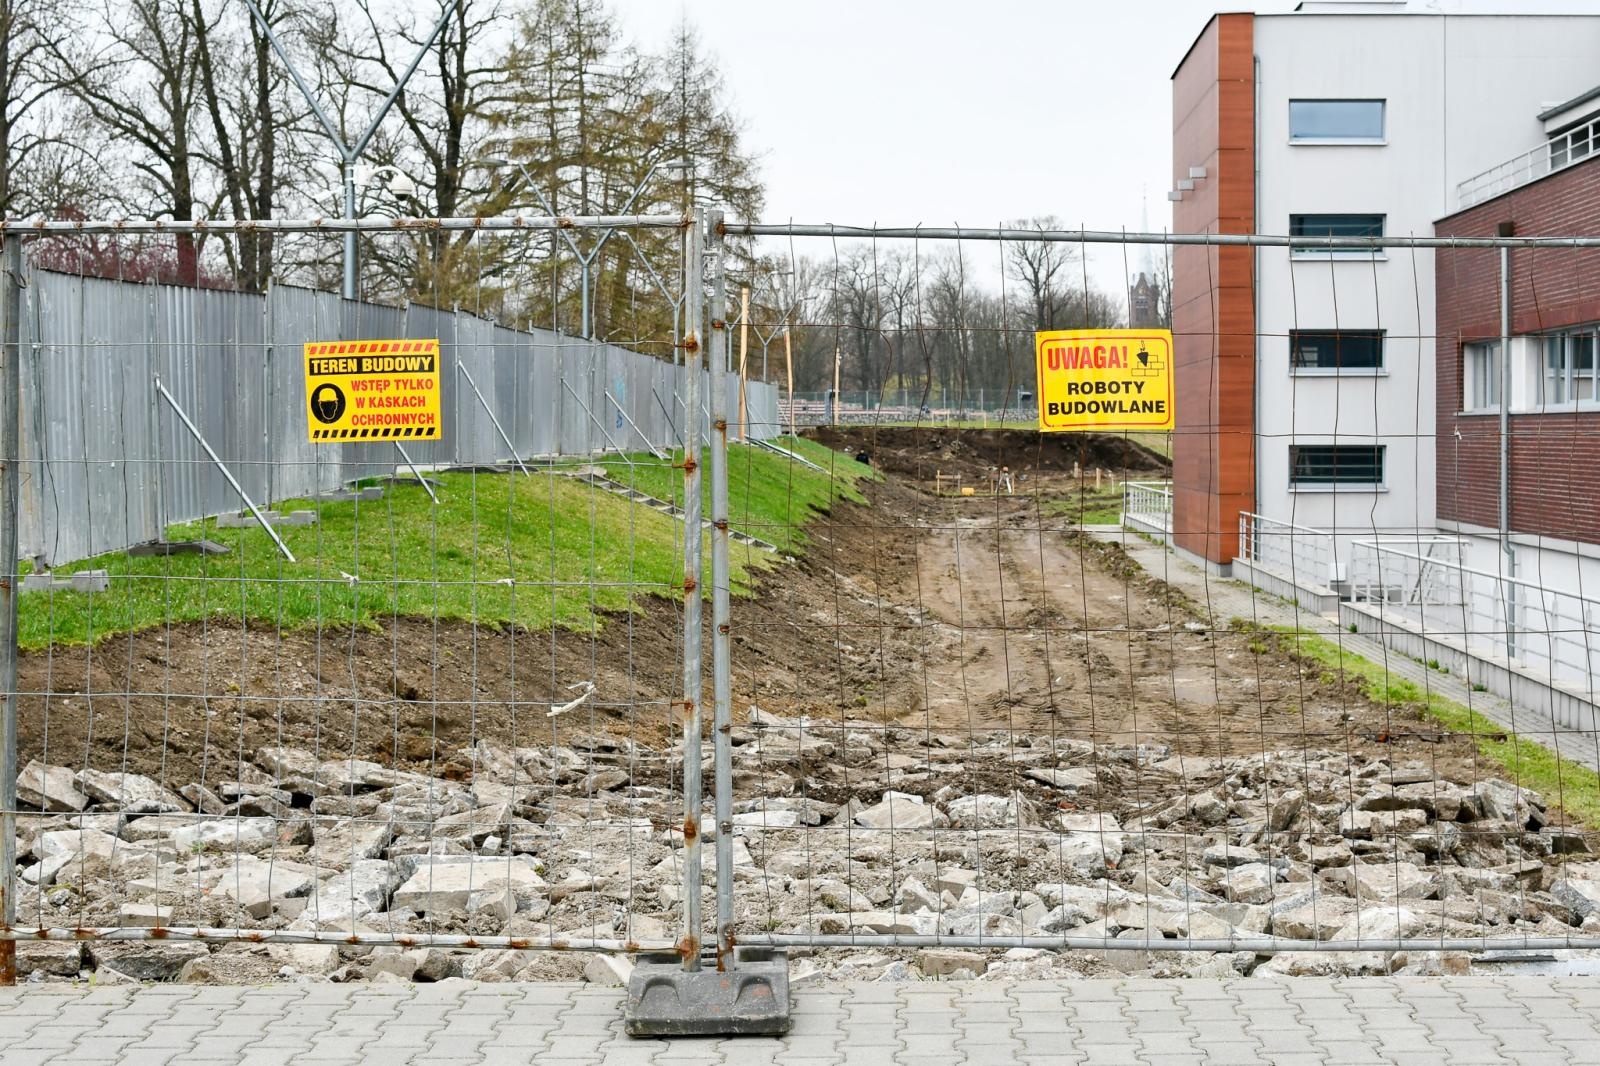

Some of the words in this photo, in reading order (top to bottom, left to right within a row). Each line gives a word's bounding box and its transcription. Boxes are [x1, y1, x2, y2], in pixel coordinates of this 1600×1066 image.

[312, 359, 357, 373] TEREN
[362, 357, 432, 372] BUDOWY
[1047, 345, 1129, 371] UWAGA!
[351, 380, 390, 393] WSTĘP
[394, 379, 433, 390] TYLKO
[1067, 381, 1146, 395] ROBOTY
[356, 397, 365, 408] W
[369, 396, 426, 408] KASKACH
[1048, 400, 1166, 416] BUDOWLANE
[351, 413, 435, 426] OCHRONNYCH
